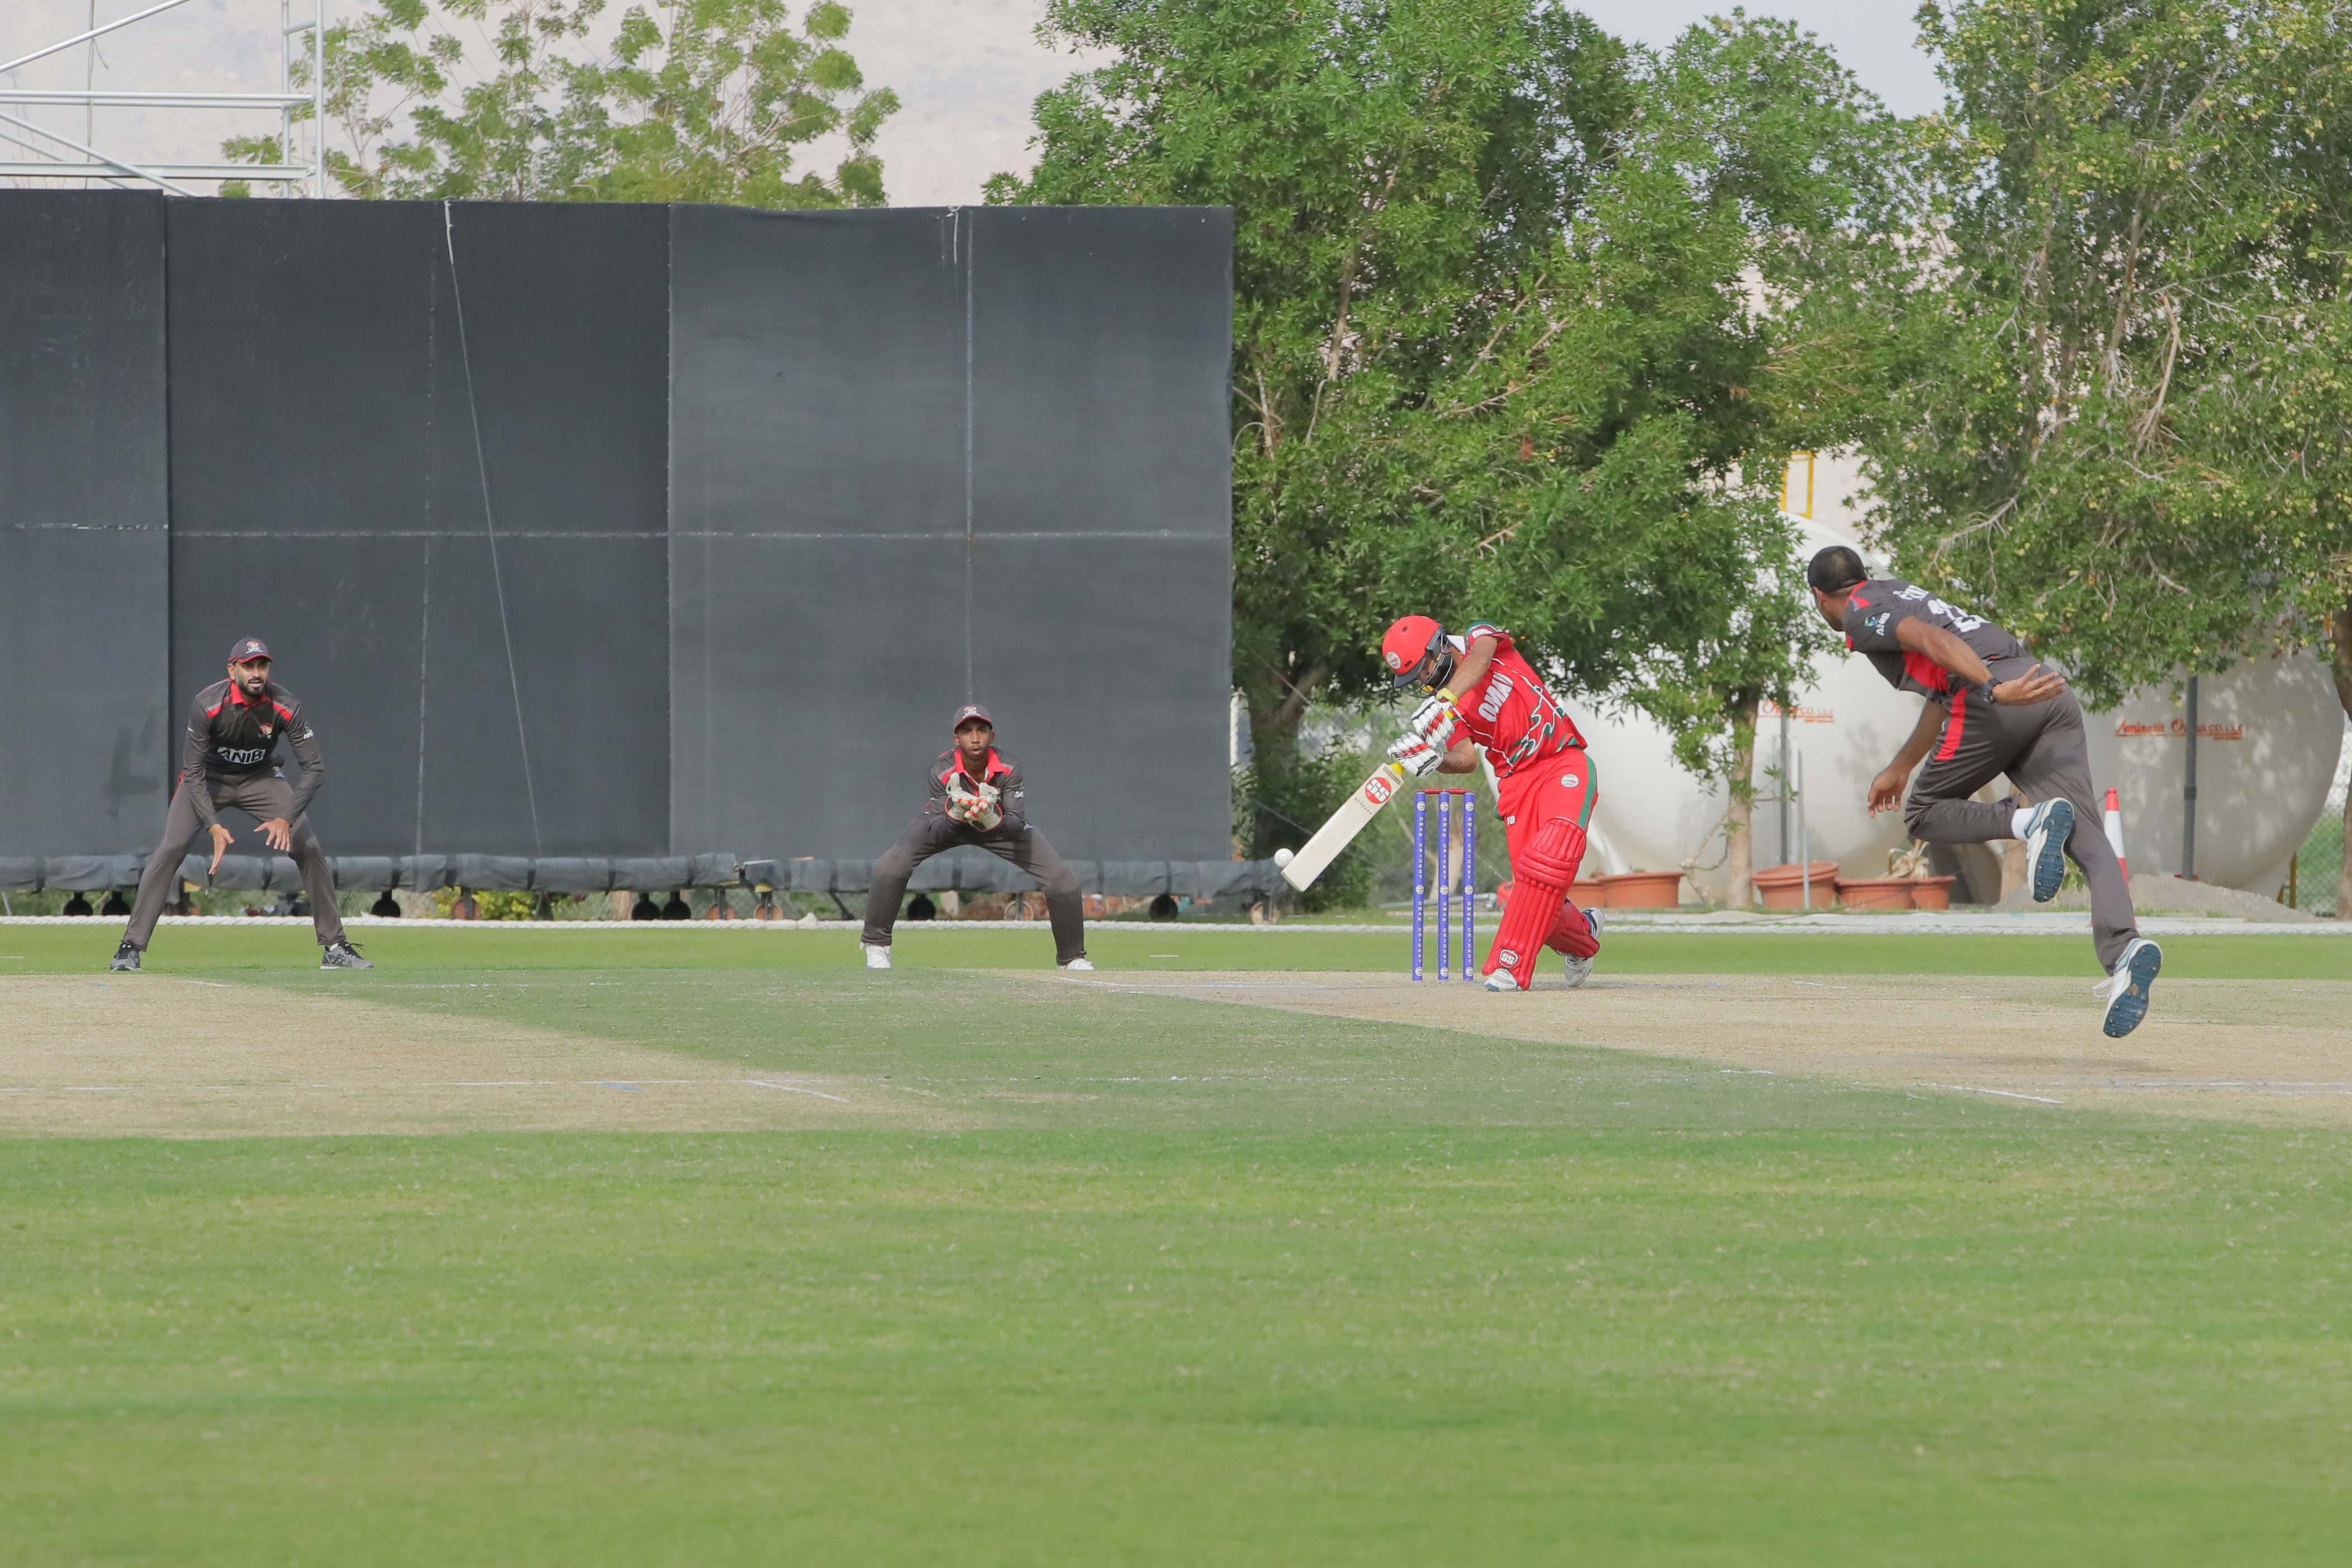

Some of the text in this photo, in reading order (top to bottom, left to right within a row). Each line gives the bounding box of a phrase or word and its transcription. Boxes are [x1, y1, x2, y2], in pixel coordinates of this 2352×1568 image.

[1876, 612, 1890, 636] ANIB
[1366, 778, 1390, 802] SS
[1500, 953, 1515, 964] SS
